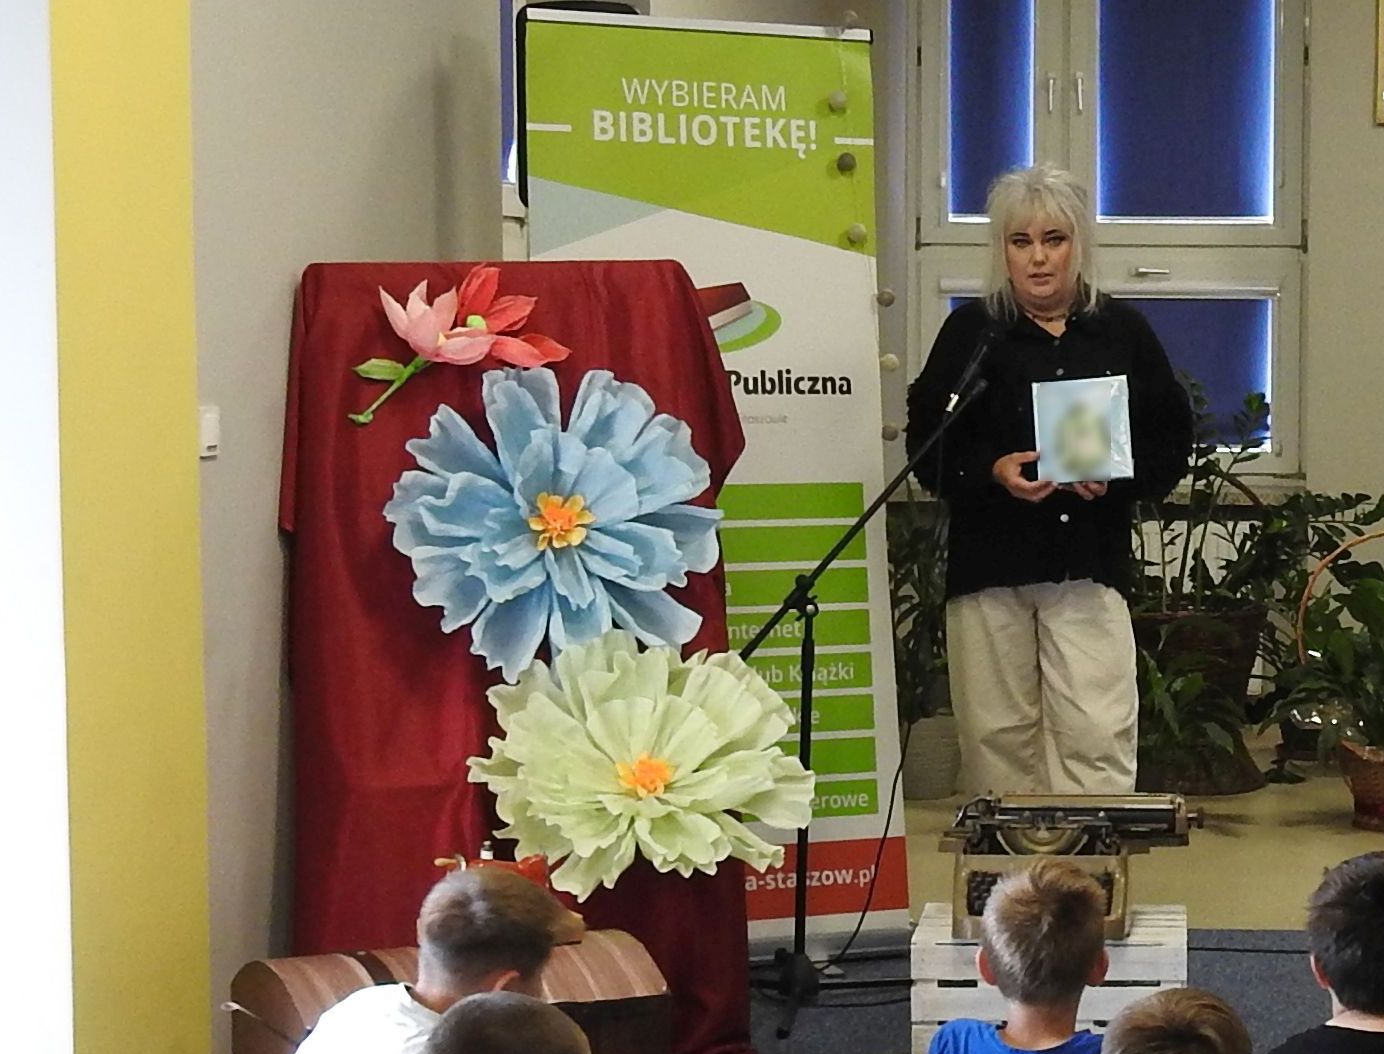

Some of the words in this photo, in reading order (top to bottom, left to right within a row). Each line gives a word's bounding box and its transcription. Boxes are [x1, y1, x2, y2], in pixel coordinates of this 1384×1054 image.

[621, 77, 787, 112] WYBIERAM
[592, 109, 817, 159] BIBLIOTEKĘ!
[726, 368, 852, 395] Publiczna
[744, 864, 876, 891] a-stazow.pl
